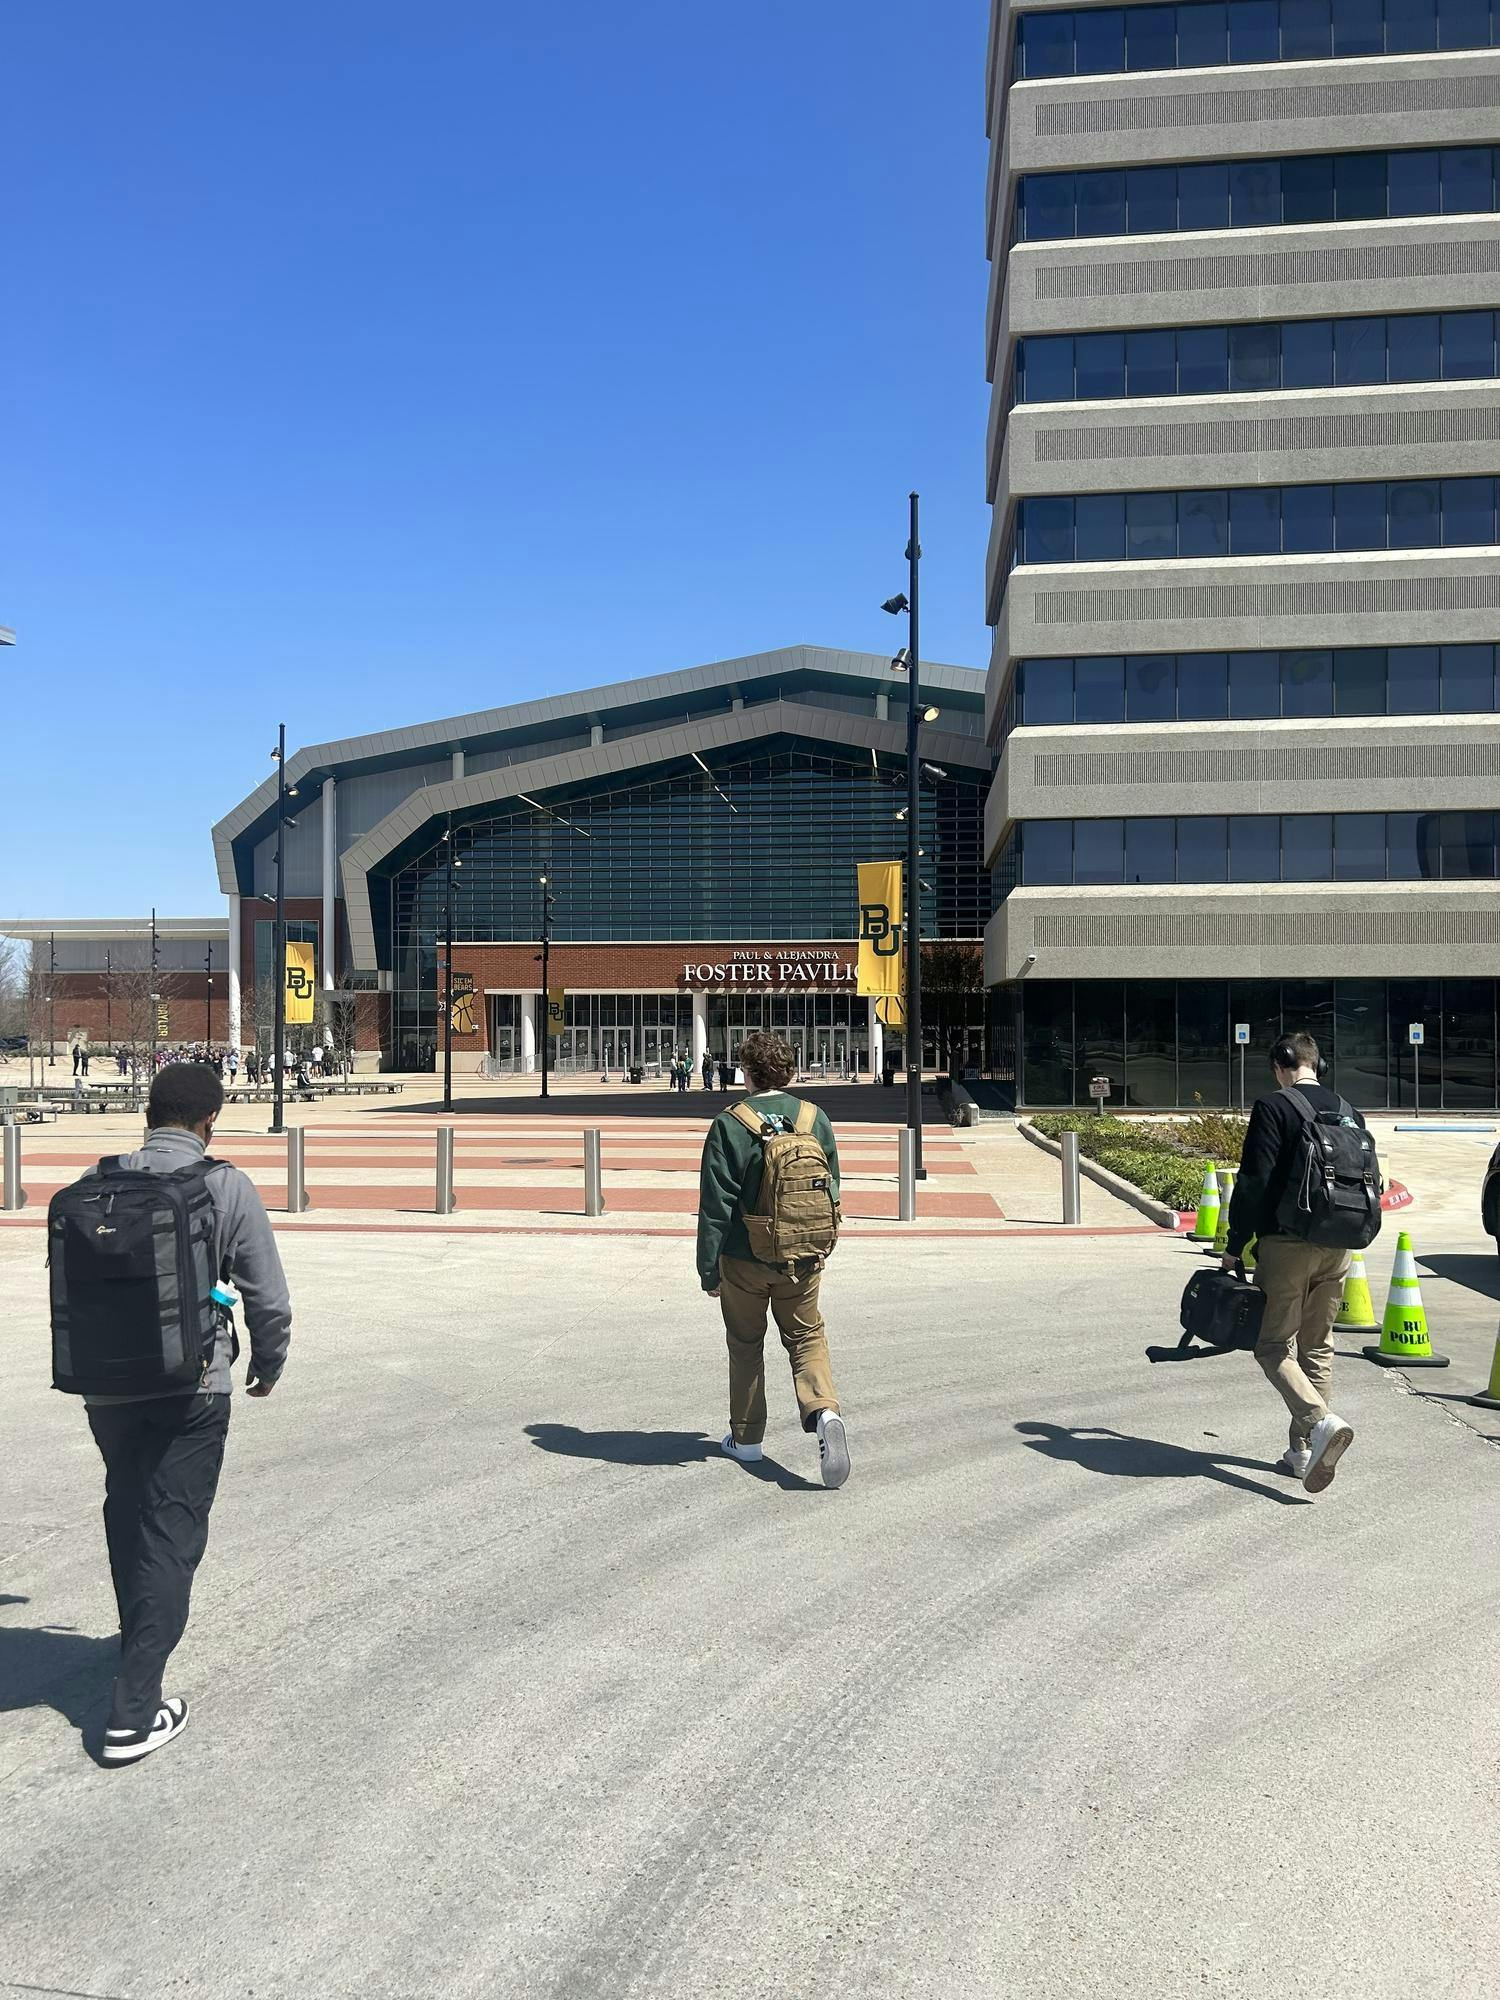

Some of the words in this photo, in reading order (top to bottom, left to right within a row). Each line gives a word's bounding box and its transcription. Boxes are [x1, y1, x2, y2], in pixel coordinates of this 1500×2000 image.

[860, 904, 901, 957] BU
[733, 951, 761, 960] PAUL
[763, 951, 772, 960] &
[776, 951, 839, 961] ALEJANDRA
[683, 963, 773, 982] FOSTER
[778, 963, 859, 981] PAVILI
[286, 966, 314, 999] BU
[548, 1002, 564, 1021] BU
[1403, 1320, 1422, 1332] BU
